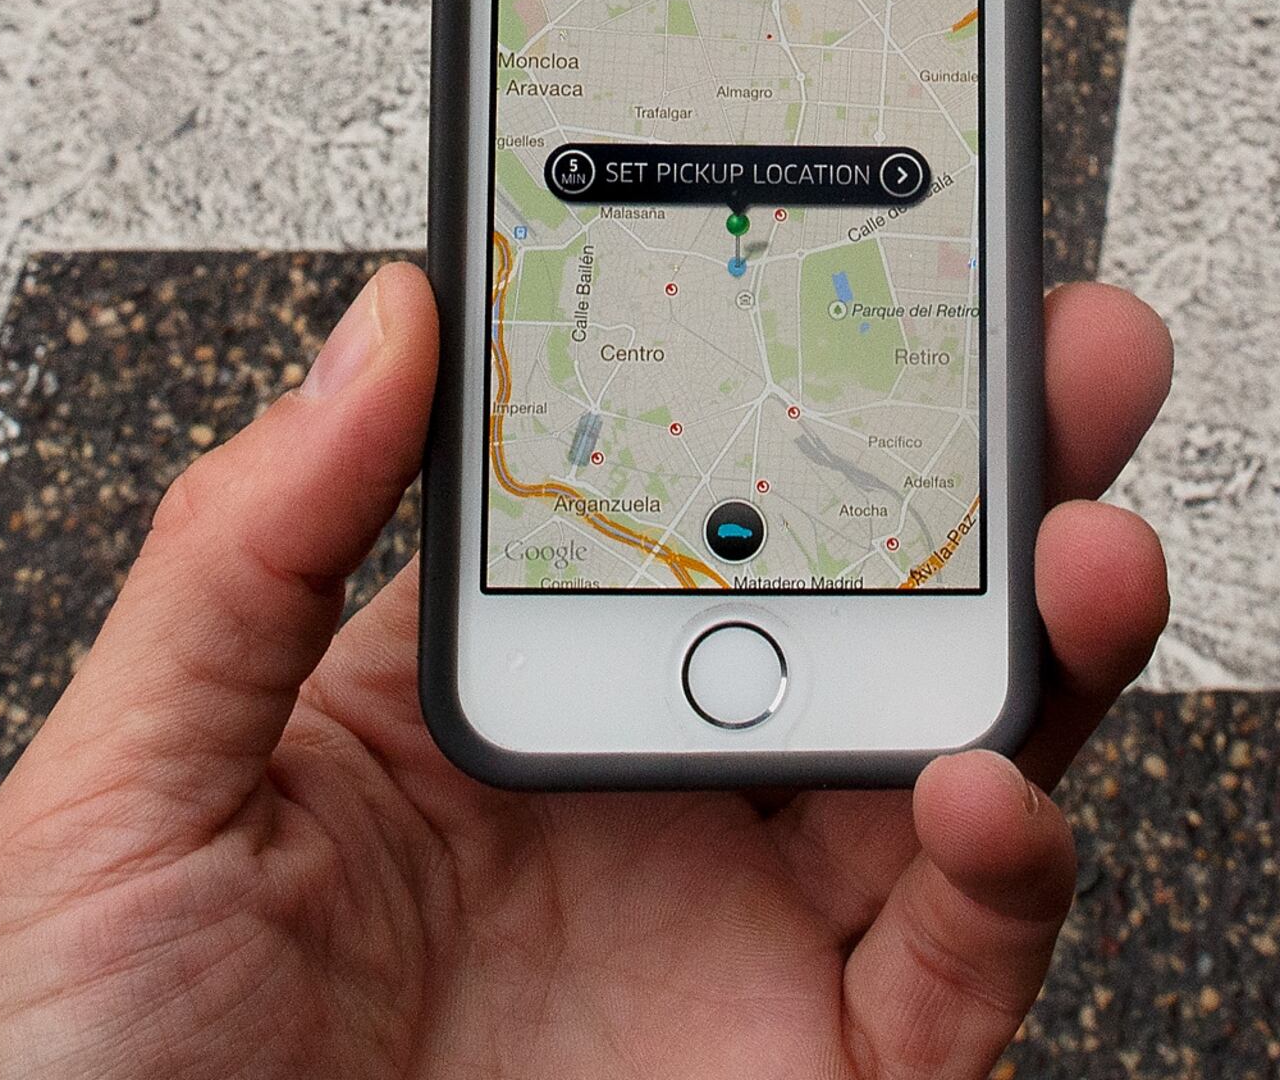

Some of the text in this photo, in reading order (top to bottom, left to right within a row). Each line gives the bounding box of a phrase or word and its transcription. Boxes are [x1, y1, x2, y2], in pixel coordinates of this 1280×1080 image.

[498, 51, 580, 70] Moncloa
[505, 79, 584, 97] Aravaca
[716, 85, 773, 101] Almagro
[634, 106, 693, 122] Trafalgar
[569, 158, 578, 172] 5
[561, 173, 586, 185] MIN
[606, 161, 871, 186] SET PICKUP LOCATION
[600, 206, 666, 220] Malasaña
[847, 214, 886, 242] Calle
[571, 244, 595, 342] Calle Bailén
[851, 303, 980, 320] Parque del Retiro
[600, 343, 666, 364] Centro
[894, 348, 951, 366] Retiro
[493, 401, 548, 417] Imperial
[868, 434, 923, 450] Pacífico
[904, 475, 955, 490] Adelfas
[554, 495, 662, 517] Arganzuela
[839, 502, 888, 518] Atocha
[933, 546, 953, 563] la
[946, 513, 977, 546] Paz
[504, 539, 588, 570] Google
[540, 576, 601, 589] Comillas
[734, 575, 864, 590] Matadero Madrid
